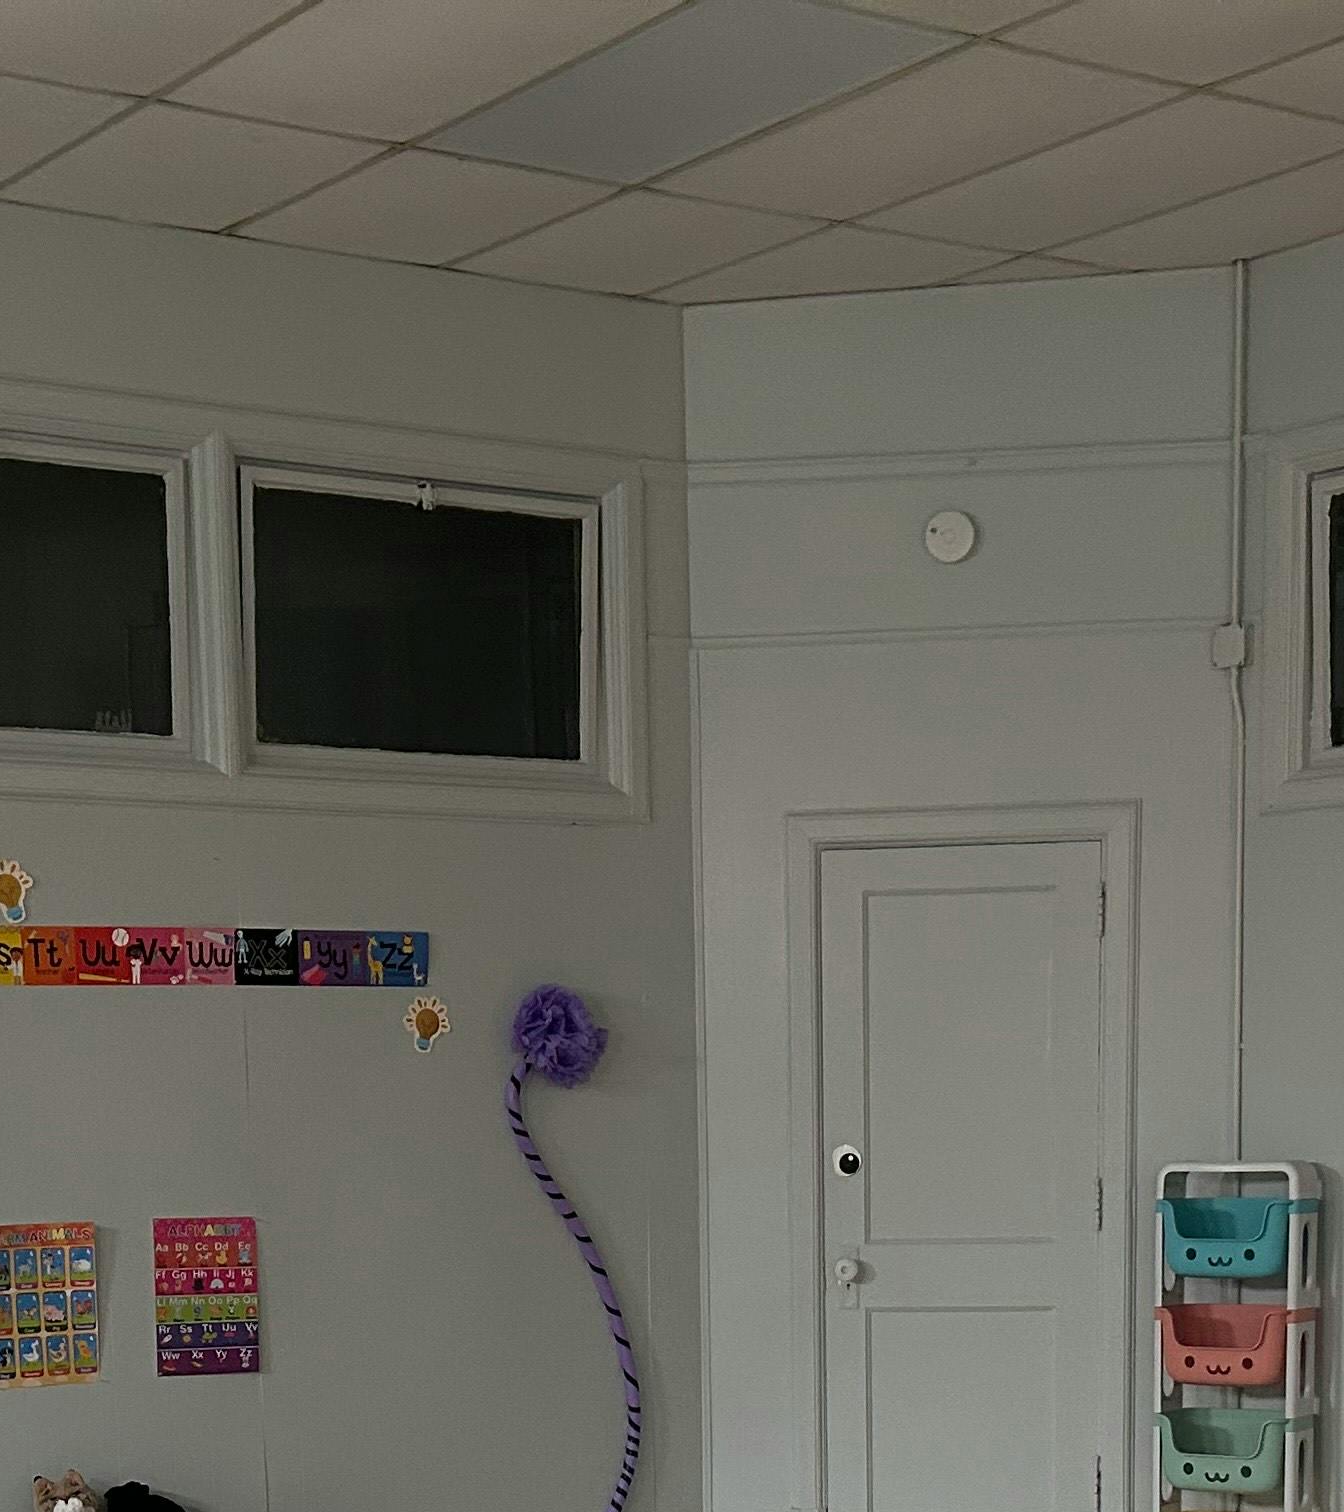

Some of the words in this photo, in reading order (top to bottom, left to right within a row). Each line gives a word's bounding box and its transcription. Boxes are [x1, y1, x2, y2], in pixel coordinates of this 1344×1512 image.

[27, 938, 63, 967] Tt
[79, 939, 120, 967] Uu
[136, 938, 181, 967] Vv
[186, 940, 233, 968] Ww
[248, 939, 287, 968] Xx
[317, 941, 348, 979] Yy
[379, 941, 414, 971] Zz
[29, 1227, 92, 1243] ANIMALS
[156, 1243, 169, 1252] Aa
[175, 1242, 189, 1251] Bb
[195, 1242, 208, 1251] Cc
[215, 1242, 229, 1251] Dd
[193, 1269, 207, 1278] Hh
[208, 1296, 222, 1304] Oo
[179, 1324, 193, 1333] Ss
[202, 1323, 212, 1332] Tt
[222, 1323, 236, 1331] Uu
[161, 1352, 180, 1360] Ww
[191, 1350, 204, 1359] Xx
[216, 1350, 227, 1360] Yy
